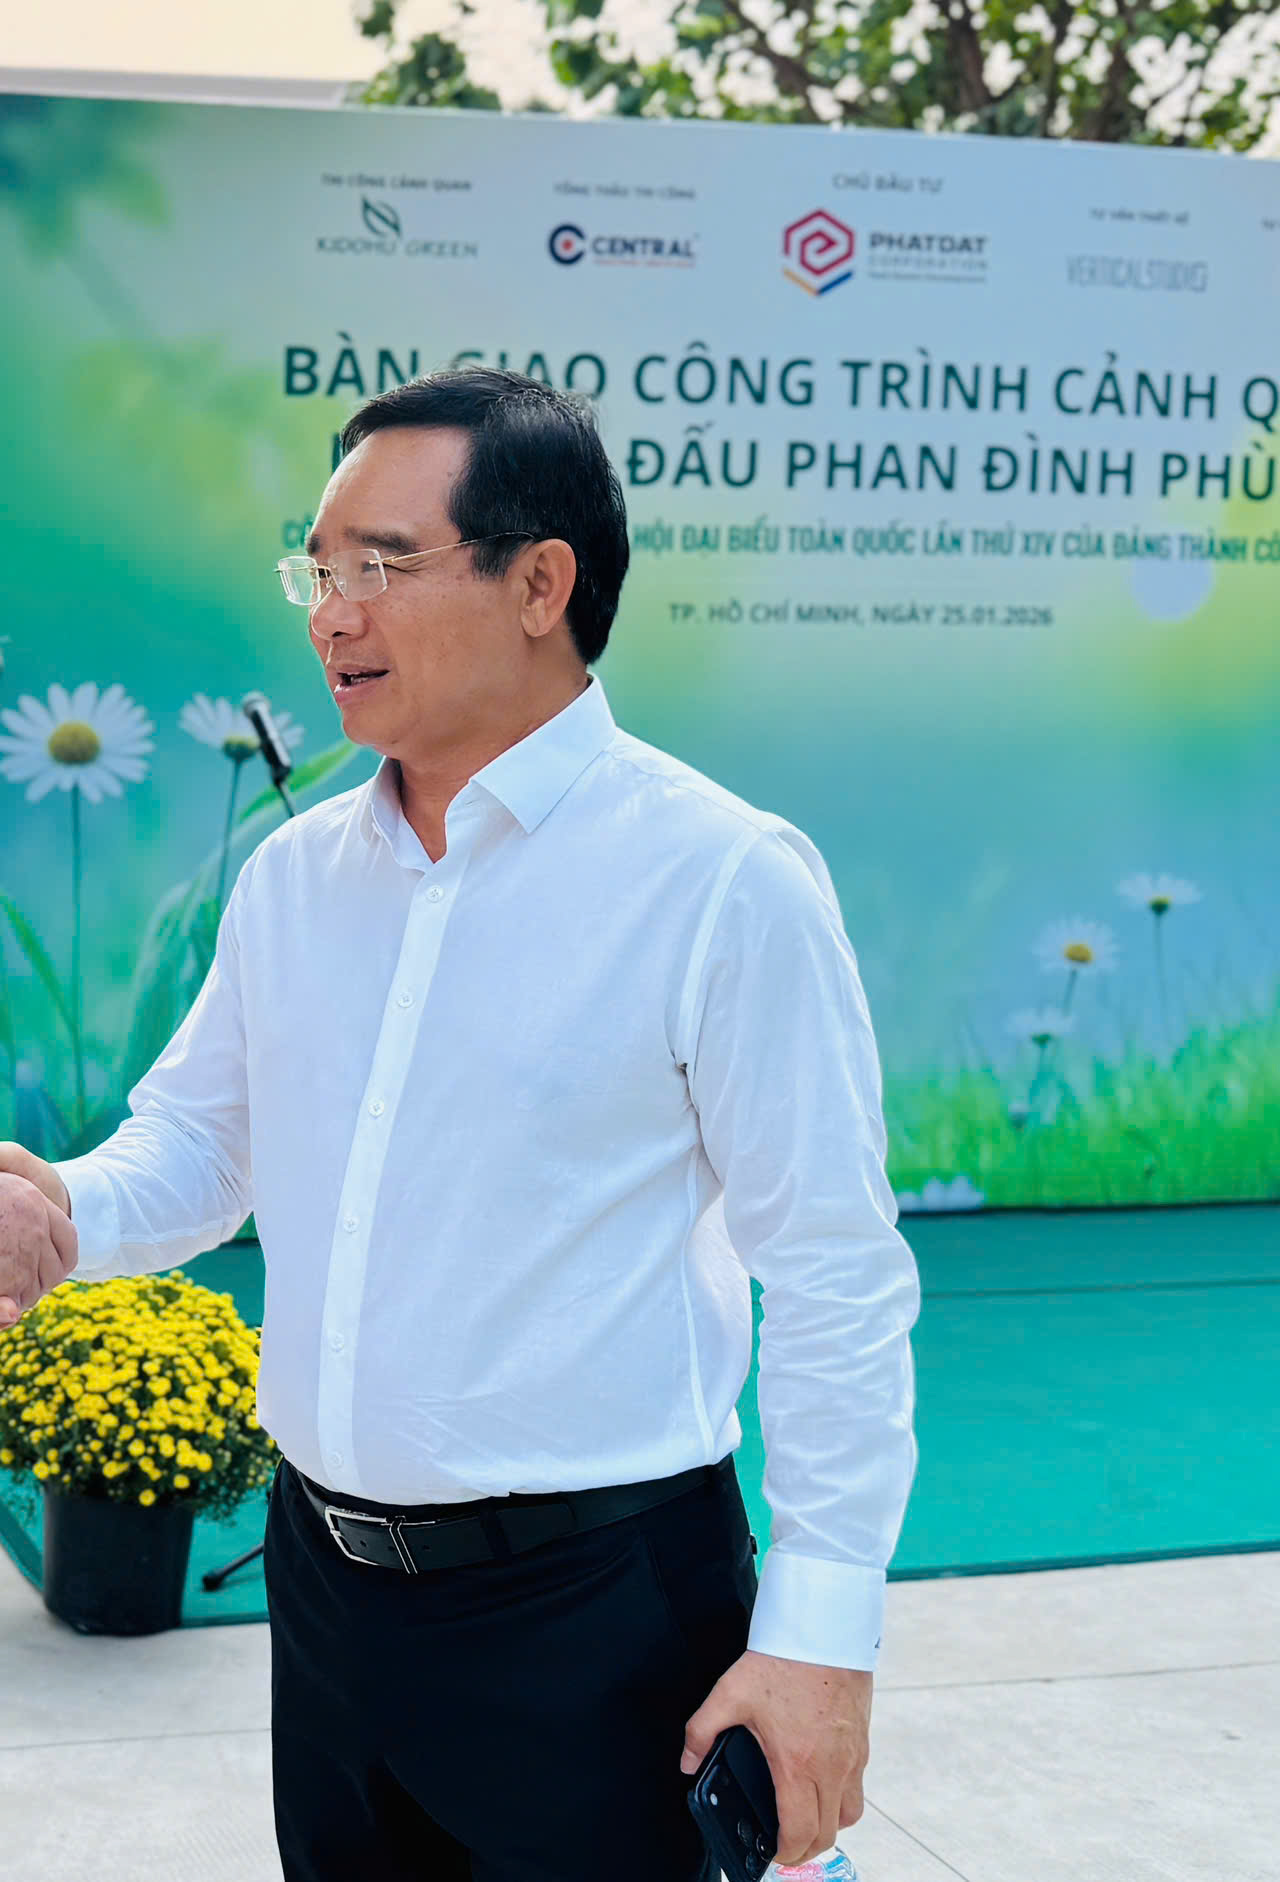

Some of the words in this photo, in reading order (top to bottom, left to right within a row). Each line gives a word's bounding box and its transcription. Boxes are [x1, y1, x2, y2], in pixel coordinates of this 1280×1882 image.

[406, 240, 478, 259] GREEN
[592, 235, 695, 257] CENTRAL
[870, 231, 987, 254] PHATDAT
[284, 330, 419, 398] BÀN
[633, 340, 815, 407] CÔNG
[841, 347, 1028, 413] TRÌNH
[1055, 351, 1217, 421] CẢNH
[627, 419, 759, 489] ĐẤU
[786, 441, 957, 492] PHAN
[982, 432, 1134, 496] ĐÌNH
[1160, 440, 1277, 501] PHÙ
[788, 517, 845, 554] TOÀN
[853, 517, 916, 559] QUỐC
[1023, 529, 1055, 557] XIV
[1063, 523, 1106, 559] CỦA
[1179, 524, 1247, 563] THÀNH
[670, 602, 700, 624] TP.
[709, 598, 744, 624] HỒ
[751, 598, 788, 624] CHÍ
[797, 602, 865, 629] MINH,
[872, 600, 934, 625] NGÀY
[941, 604, 1054, 627] 25.01.2026
